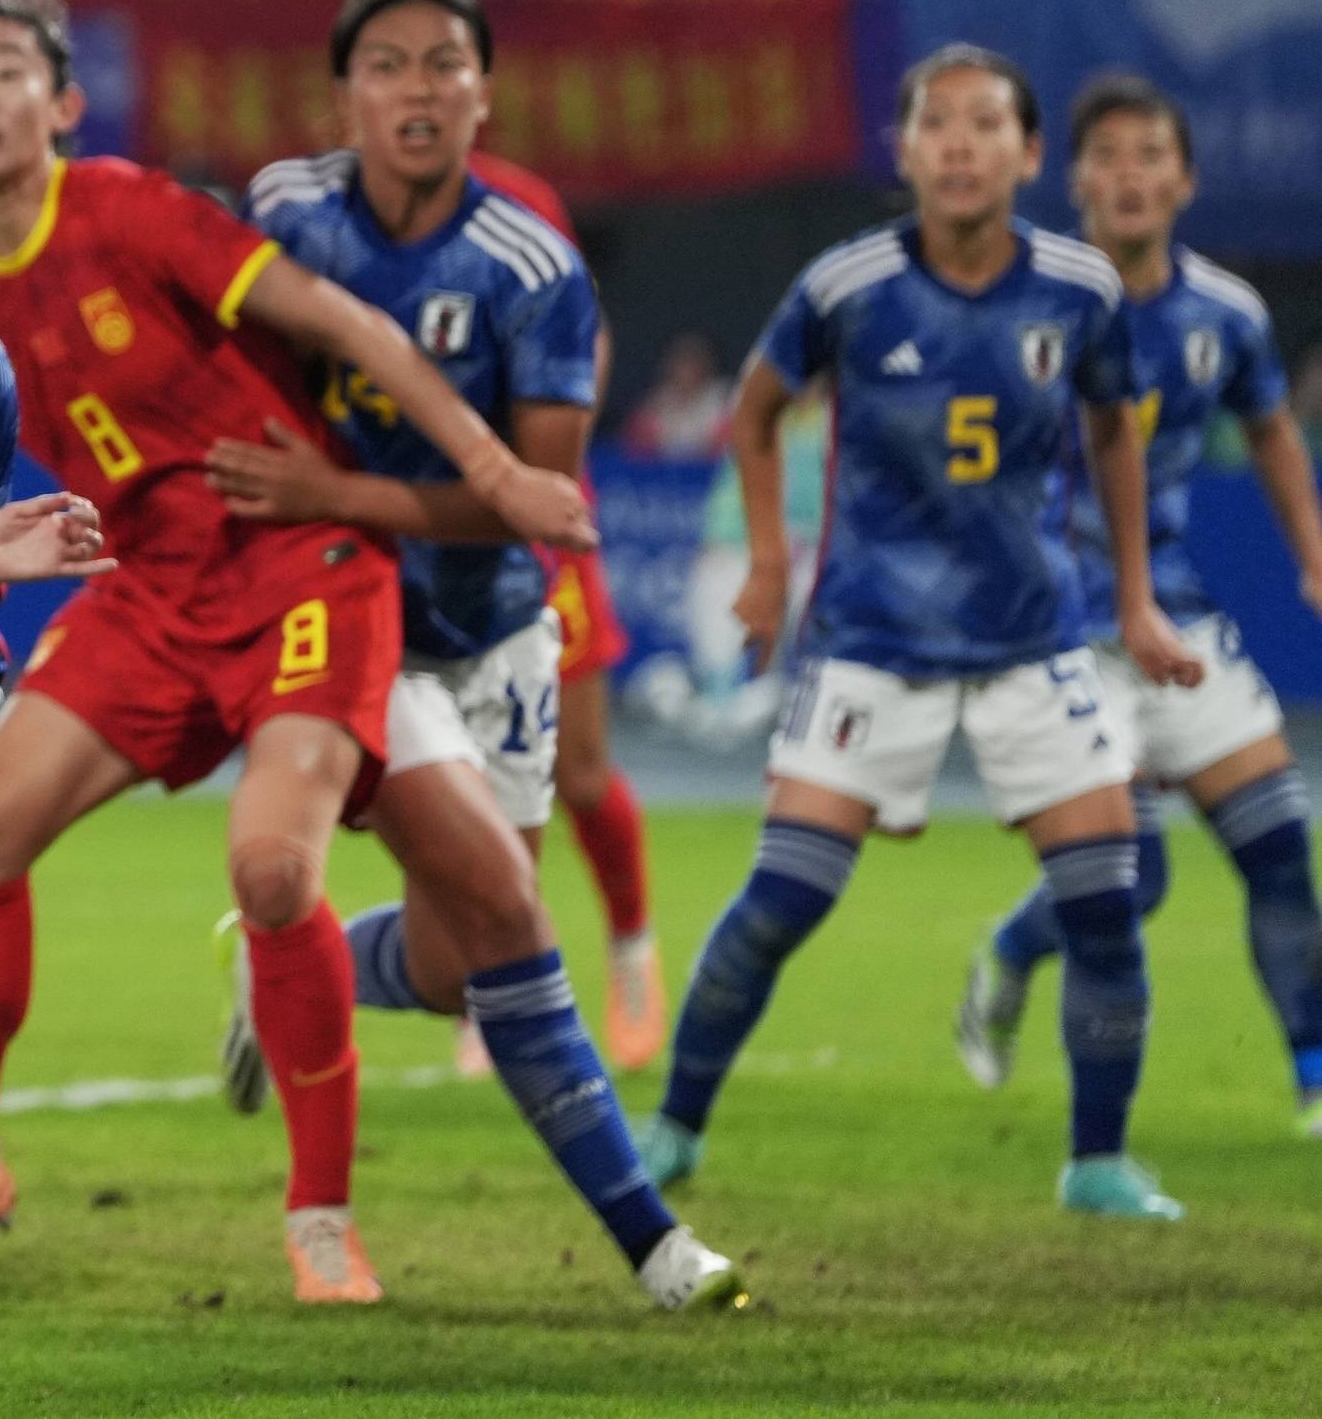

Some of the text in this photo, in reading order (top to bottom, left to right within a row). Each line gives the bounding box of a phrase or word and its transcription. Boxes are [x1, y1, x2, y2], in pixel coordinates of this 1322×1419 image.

[67, 393, 144, 482] 8
[946, 396, 1000, 484] 5
[280, 598, 329, 671] 8
